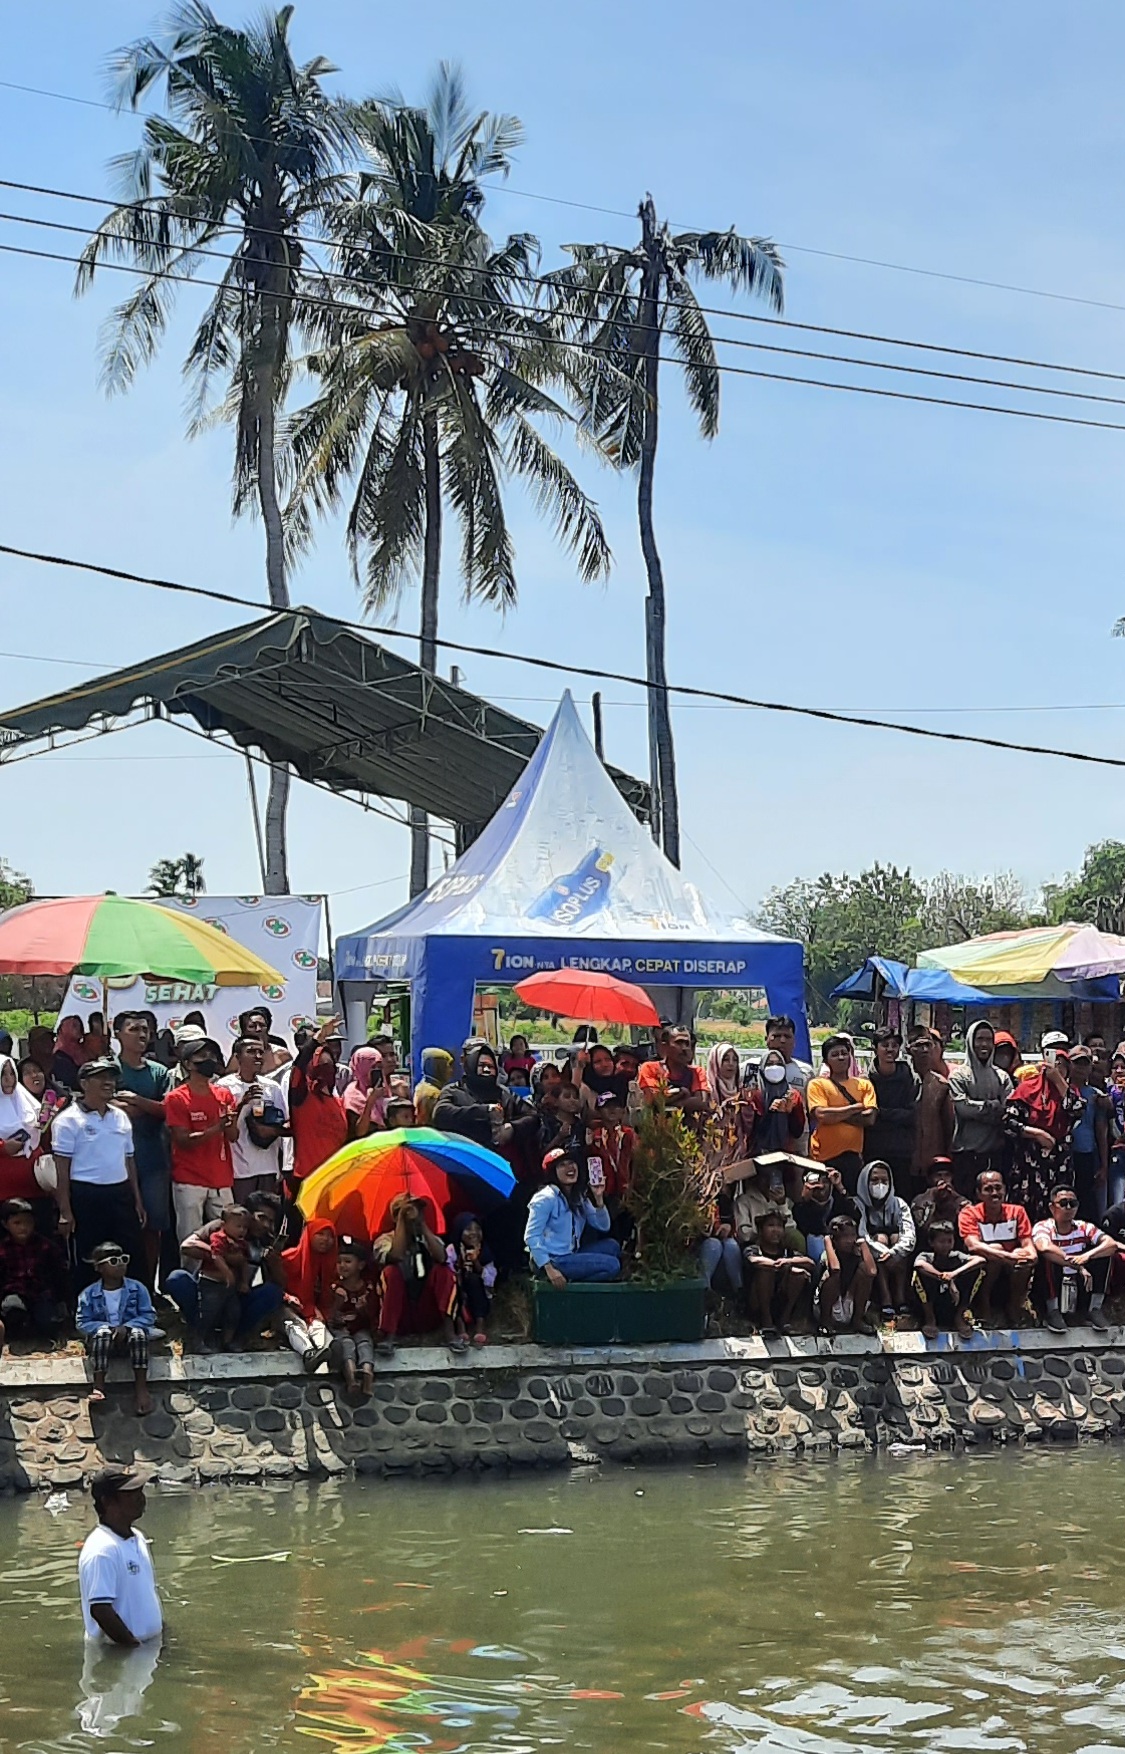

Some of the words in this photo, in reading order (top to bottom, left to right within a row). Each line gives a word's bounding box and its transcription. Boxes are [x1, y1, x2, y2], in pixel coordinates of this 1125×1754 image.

[634, 958, 681, 973] CEPAT
[683, 959, 747, 974] DISERAP
[145, 982, 218, 1004] SEHAT
